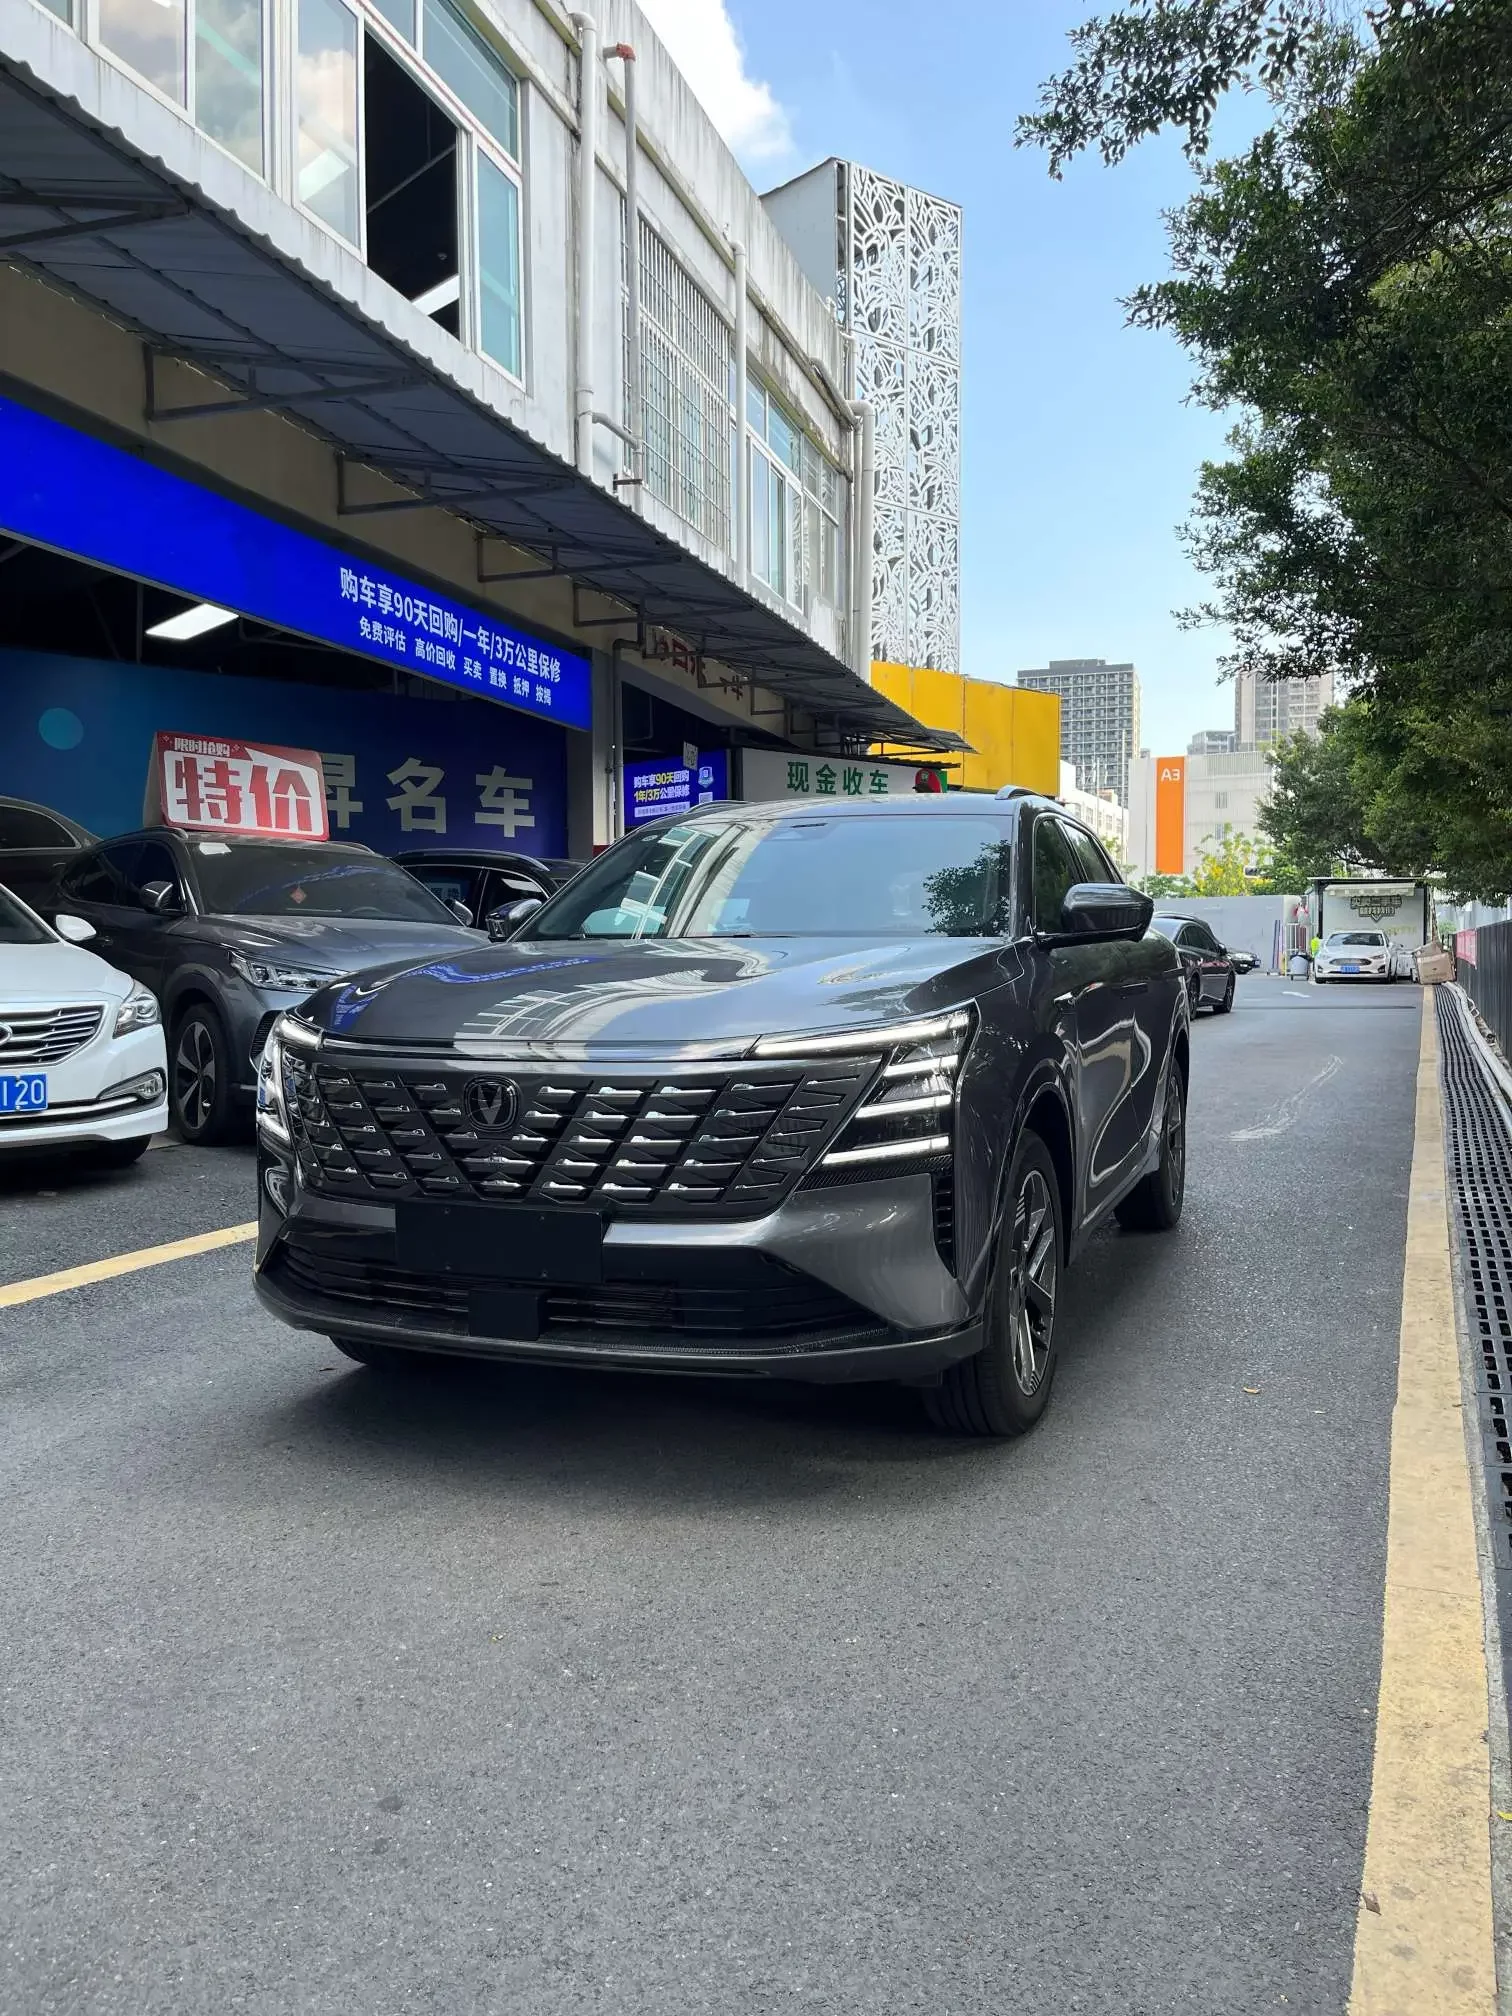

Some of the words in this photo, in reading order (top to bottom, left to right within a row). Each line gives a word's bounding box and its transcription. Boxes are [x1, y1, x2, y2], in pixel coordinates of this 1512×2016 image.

[340, 566, 561, 683] 购车享90天回购/一年/3万公里保修
[360, 615, 406, 653] 免费评估
[415, 637, 456, 671] 高价回收
[463, 656, 483, 681] 买卖
[489, 666, 507, 690] 置换
[513, 675, 530, 698] 抵押
[535, 683, 552, 706] 按揭
[633, 769, 690, 788] 购车享90天回购
[787, 761, 889, 795] 现金收车
[1160, 767, 1181, 782] A3
[174, 756, 313, 833] 特价
[633, 784, 690, 803] 1年/3万公里保修
